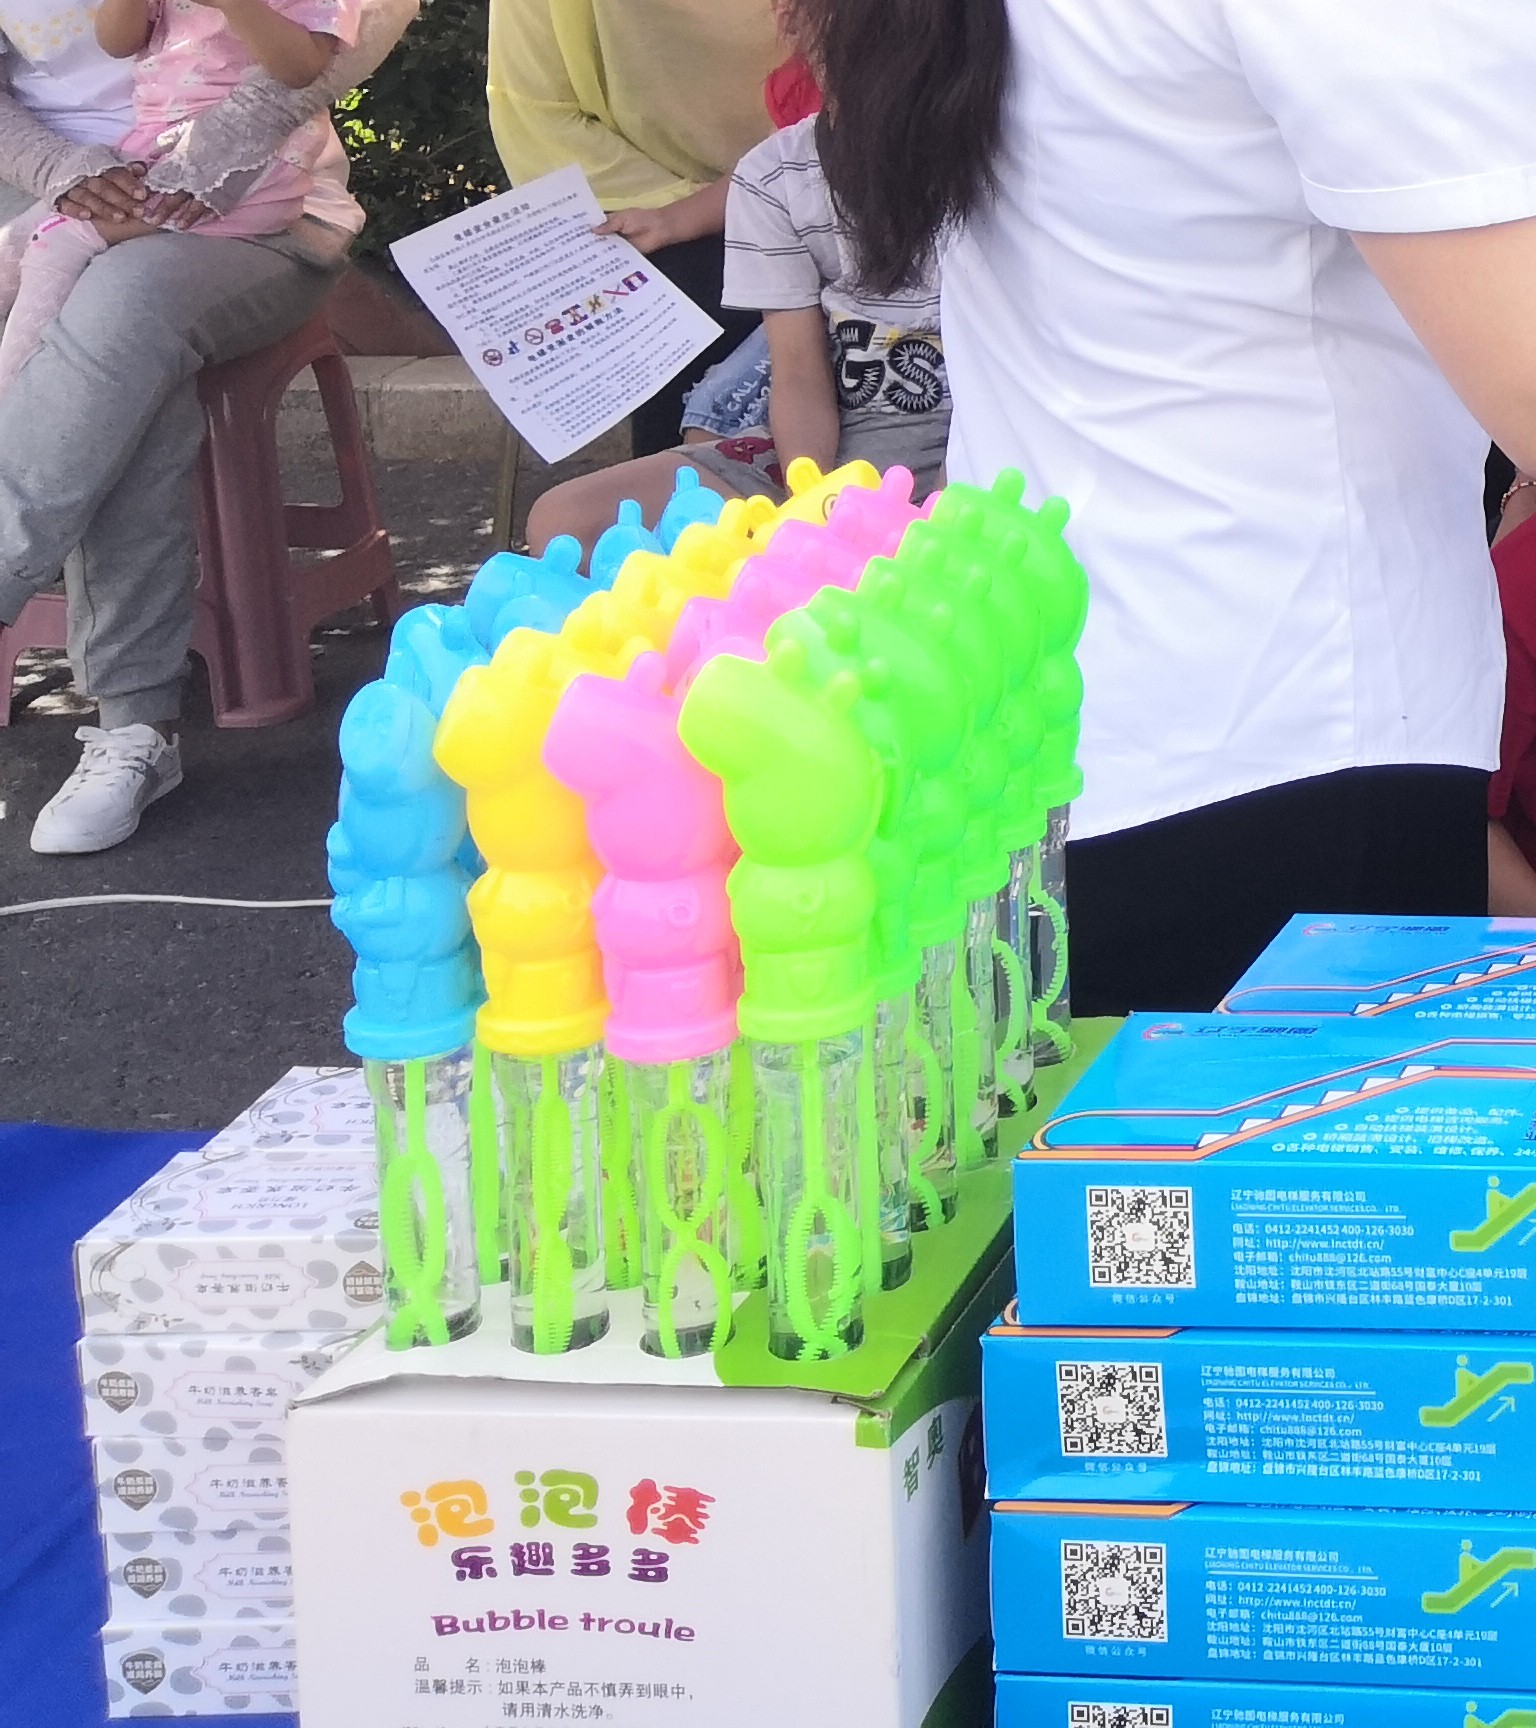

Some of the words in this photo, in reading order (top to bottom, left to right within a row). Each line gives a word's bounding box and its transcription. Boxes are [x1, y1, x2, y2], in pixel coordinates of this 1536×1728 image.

[400, 1468, 717, 1548] 泡泡棒
[450, 1541, 670, 1584] 乐趣多多
[430, 1609, 569, 1638] Bubble
[579, 1611, 697, 1643] troule
